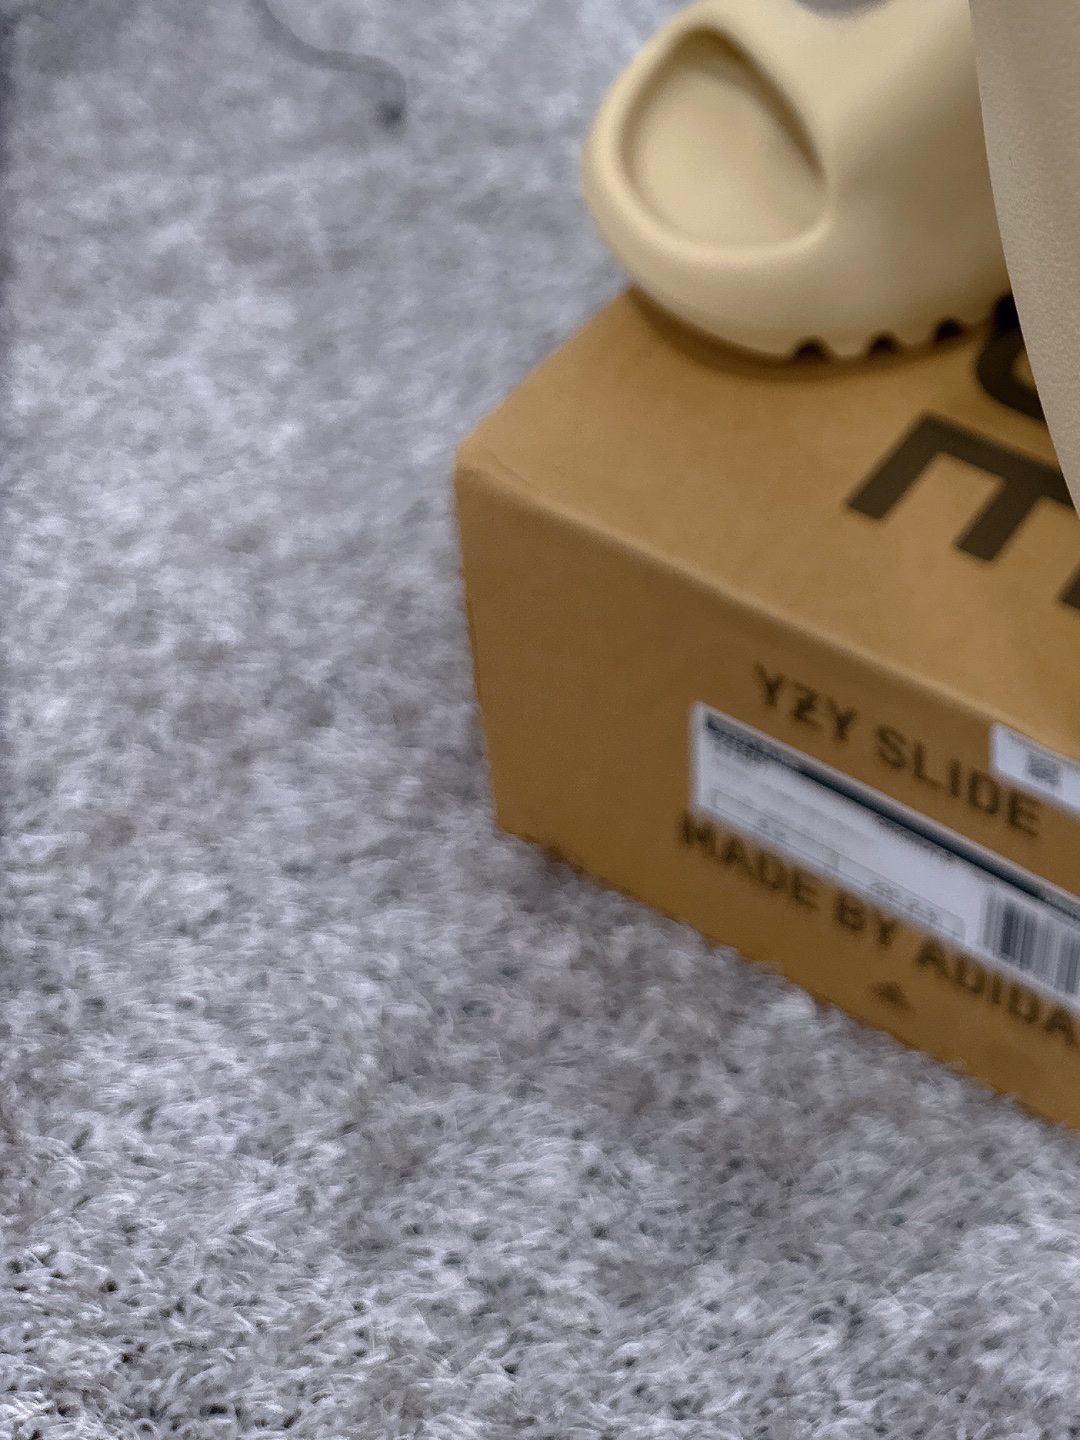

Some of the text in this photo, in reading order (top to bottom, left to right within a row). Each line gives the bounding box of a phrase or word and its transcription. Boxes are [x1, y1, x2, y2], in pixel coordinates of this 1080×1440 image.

[753, 661, 857, 742] YZY
[874, 722, 1042, 837] SLIDE
[677, 809, 820, 911] MADE
[833, 891, 899, 948] BY
